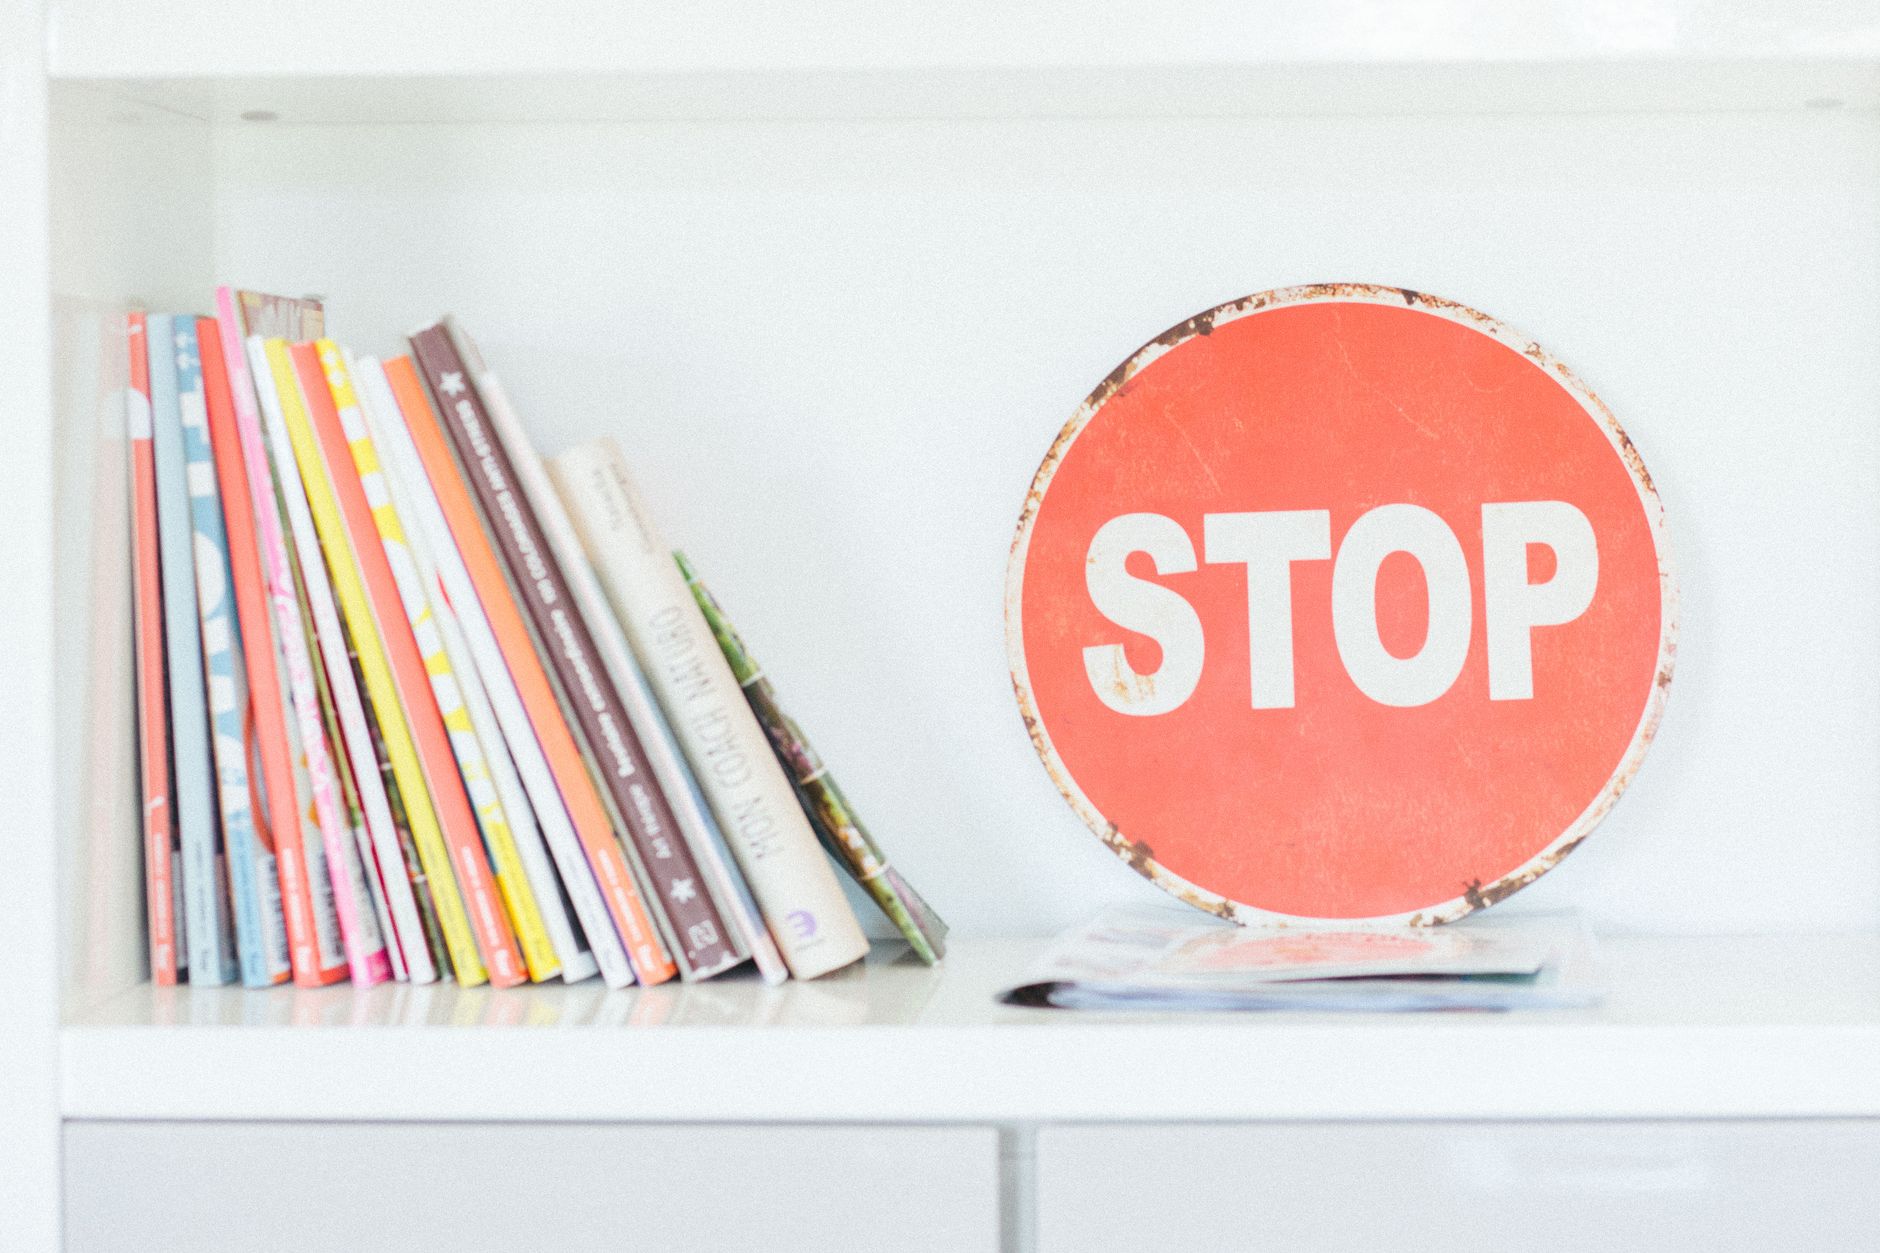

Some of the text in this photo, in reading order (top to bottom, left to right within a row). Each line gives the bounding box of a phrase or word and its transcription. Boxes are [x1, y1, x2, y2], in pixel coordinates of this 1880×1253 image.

[1082, 501, 1599, 717] STOP
[645, 602, 786, 863] MON COACH NATURO
